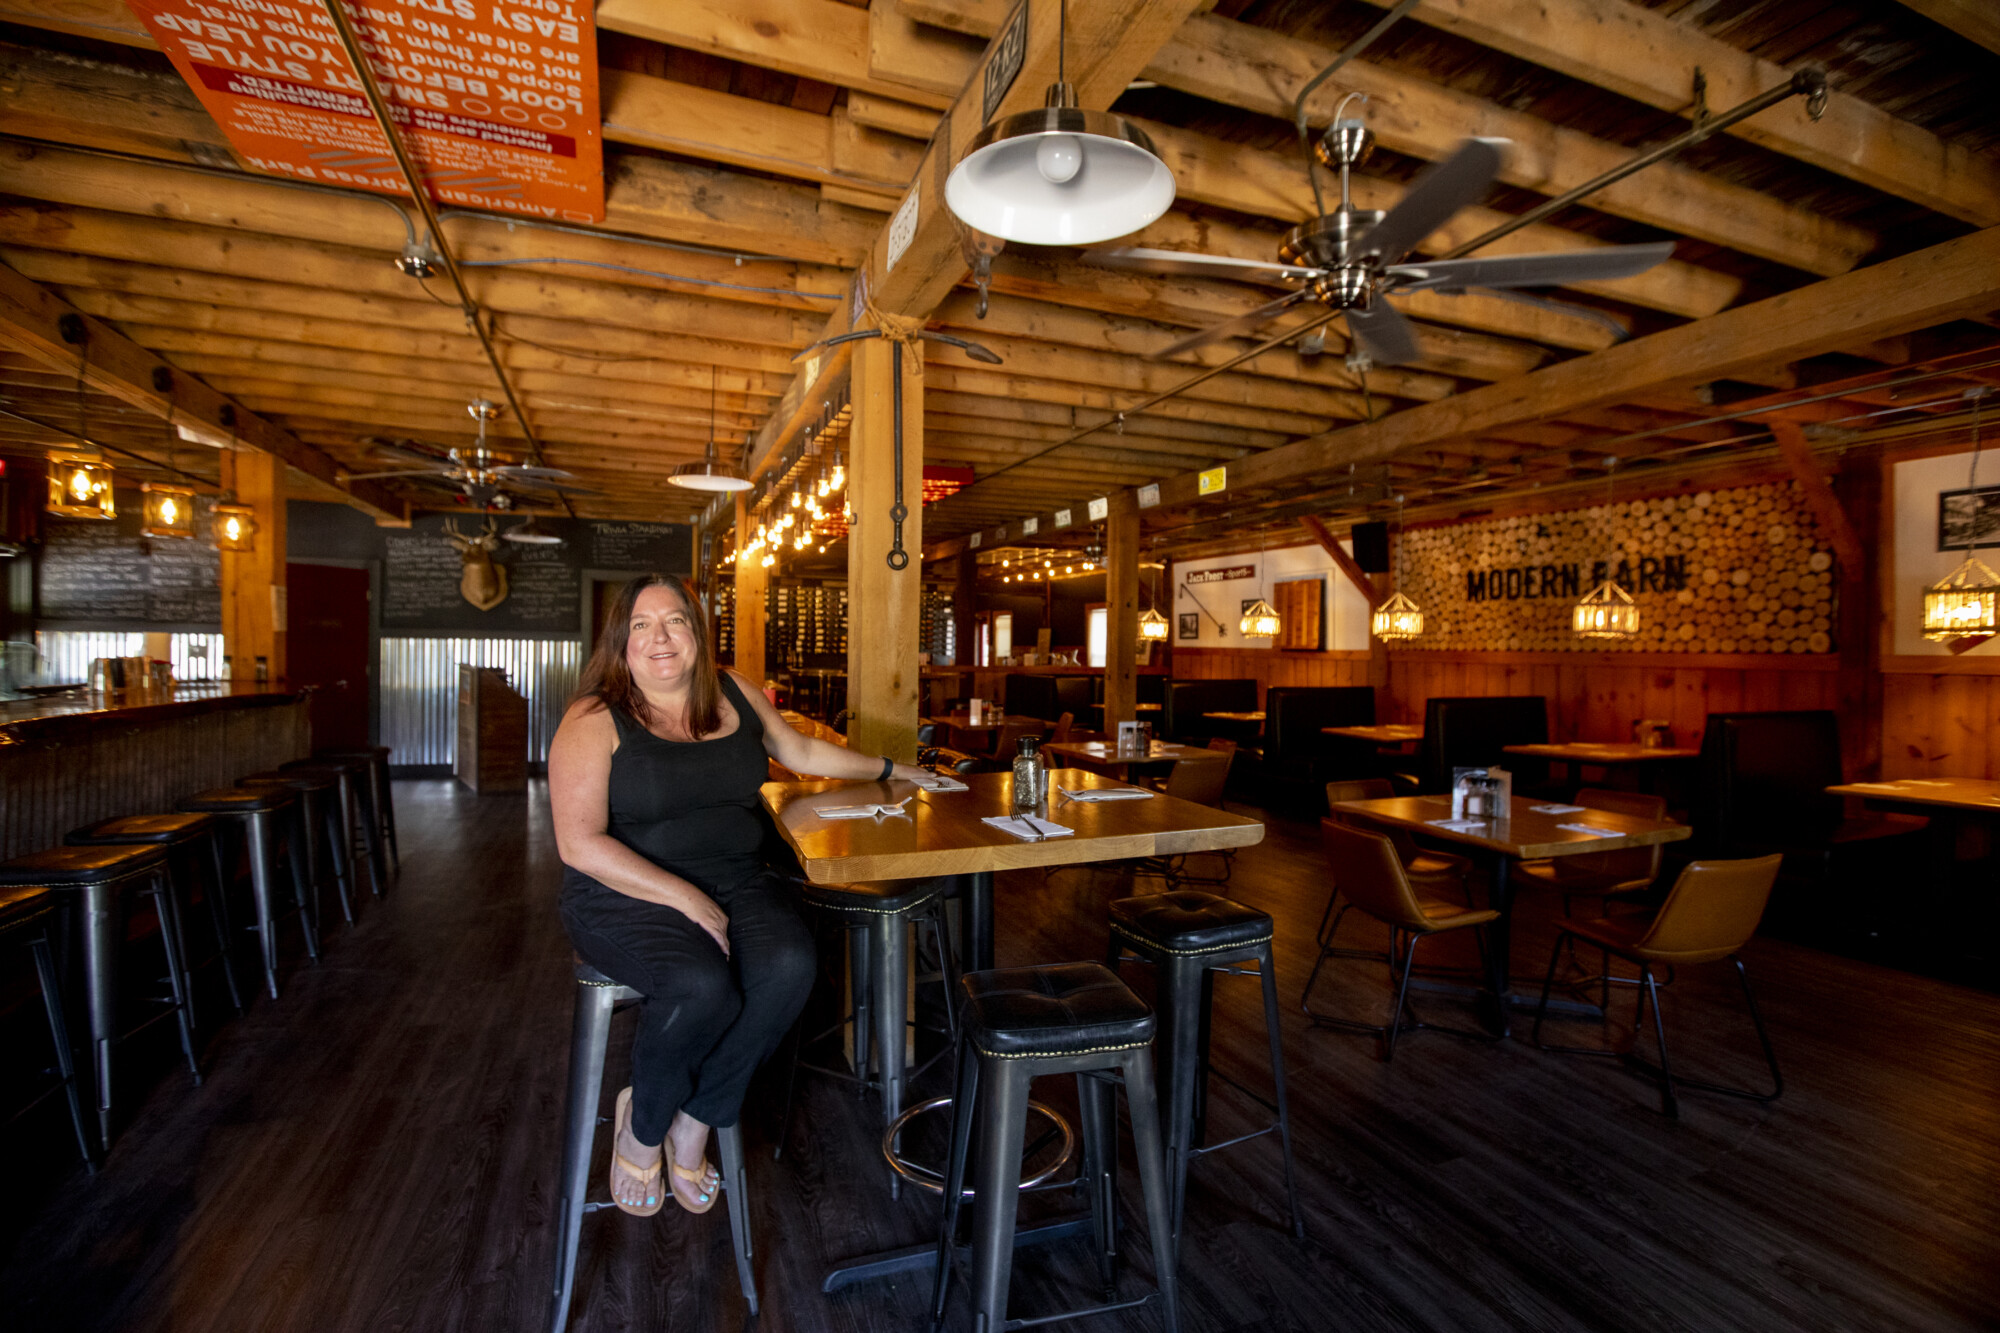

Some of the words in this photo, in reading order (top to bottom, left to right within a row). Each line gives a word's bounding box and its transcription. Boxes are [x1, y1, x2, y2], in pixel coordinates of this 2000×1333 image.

[492, 6, 579, 44] EASY
[498, 0, 578, 22] Terr
[153, 11, 255, 47] LEAP
[262, 18, 342, 46] umps
[410, 17, 450, 38] No
[456, 27, 531, 54] clear.
[177, 37, 313, 81] STYLE
[259, 34, 343, 67] YOU
[396, 31, 475, 61] them.
[538, 45, 579, 65] are
[408, 51, 500, 80] around
[478, 50, 535, 71] over
[542, 63, 581, 81] not
[229, 82, 371, 115] somersaulting
[234, 74, 365, 106] PERMITTED.
[495, 84, 582, 114] LOOK
[505, 71, 581, 99] Scope
[411, 107, 445, 122] are
[413, 117, 478, 138] aerials
[447, 113, 547, 141] maneuvers
[314, 136, 393, 156] ANGEROUS
[479, 130, 552, 153] Inverted
[244, 155, 316, 179] Park
[321, 167, 431, 198] xpress
[438, 189, 557, 217] American
[1467, 563, 1579, 601] MODERN
